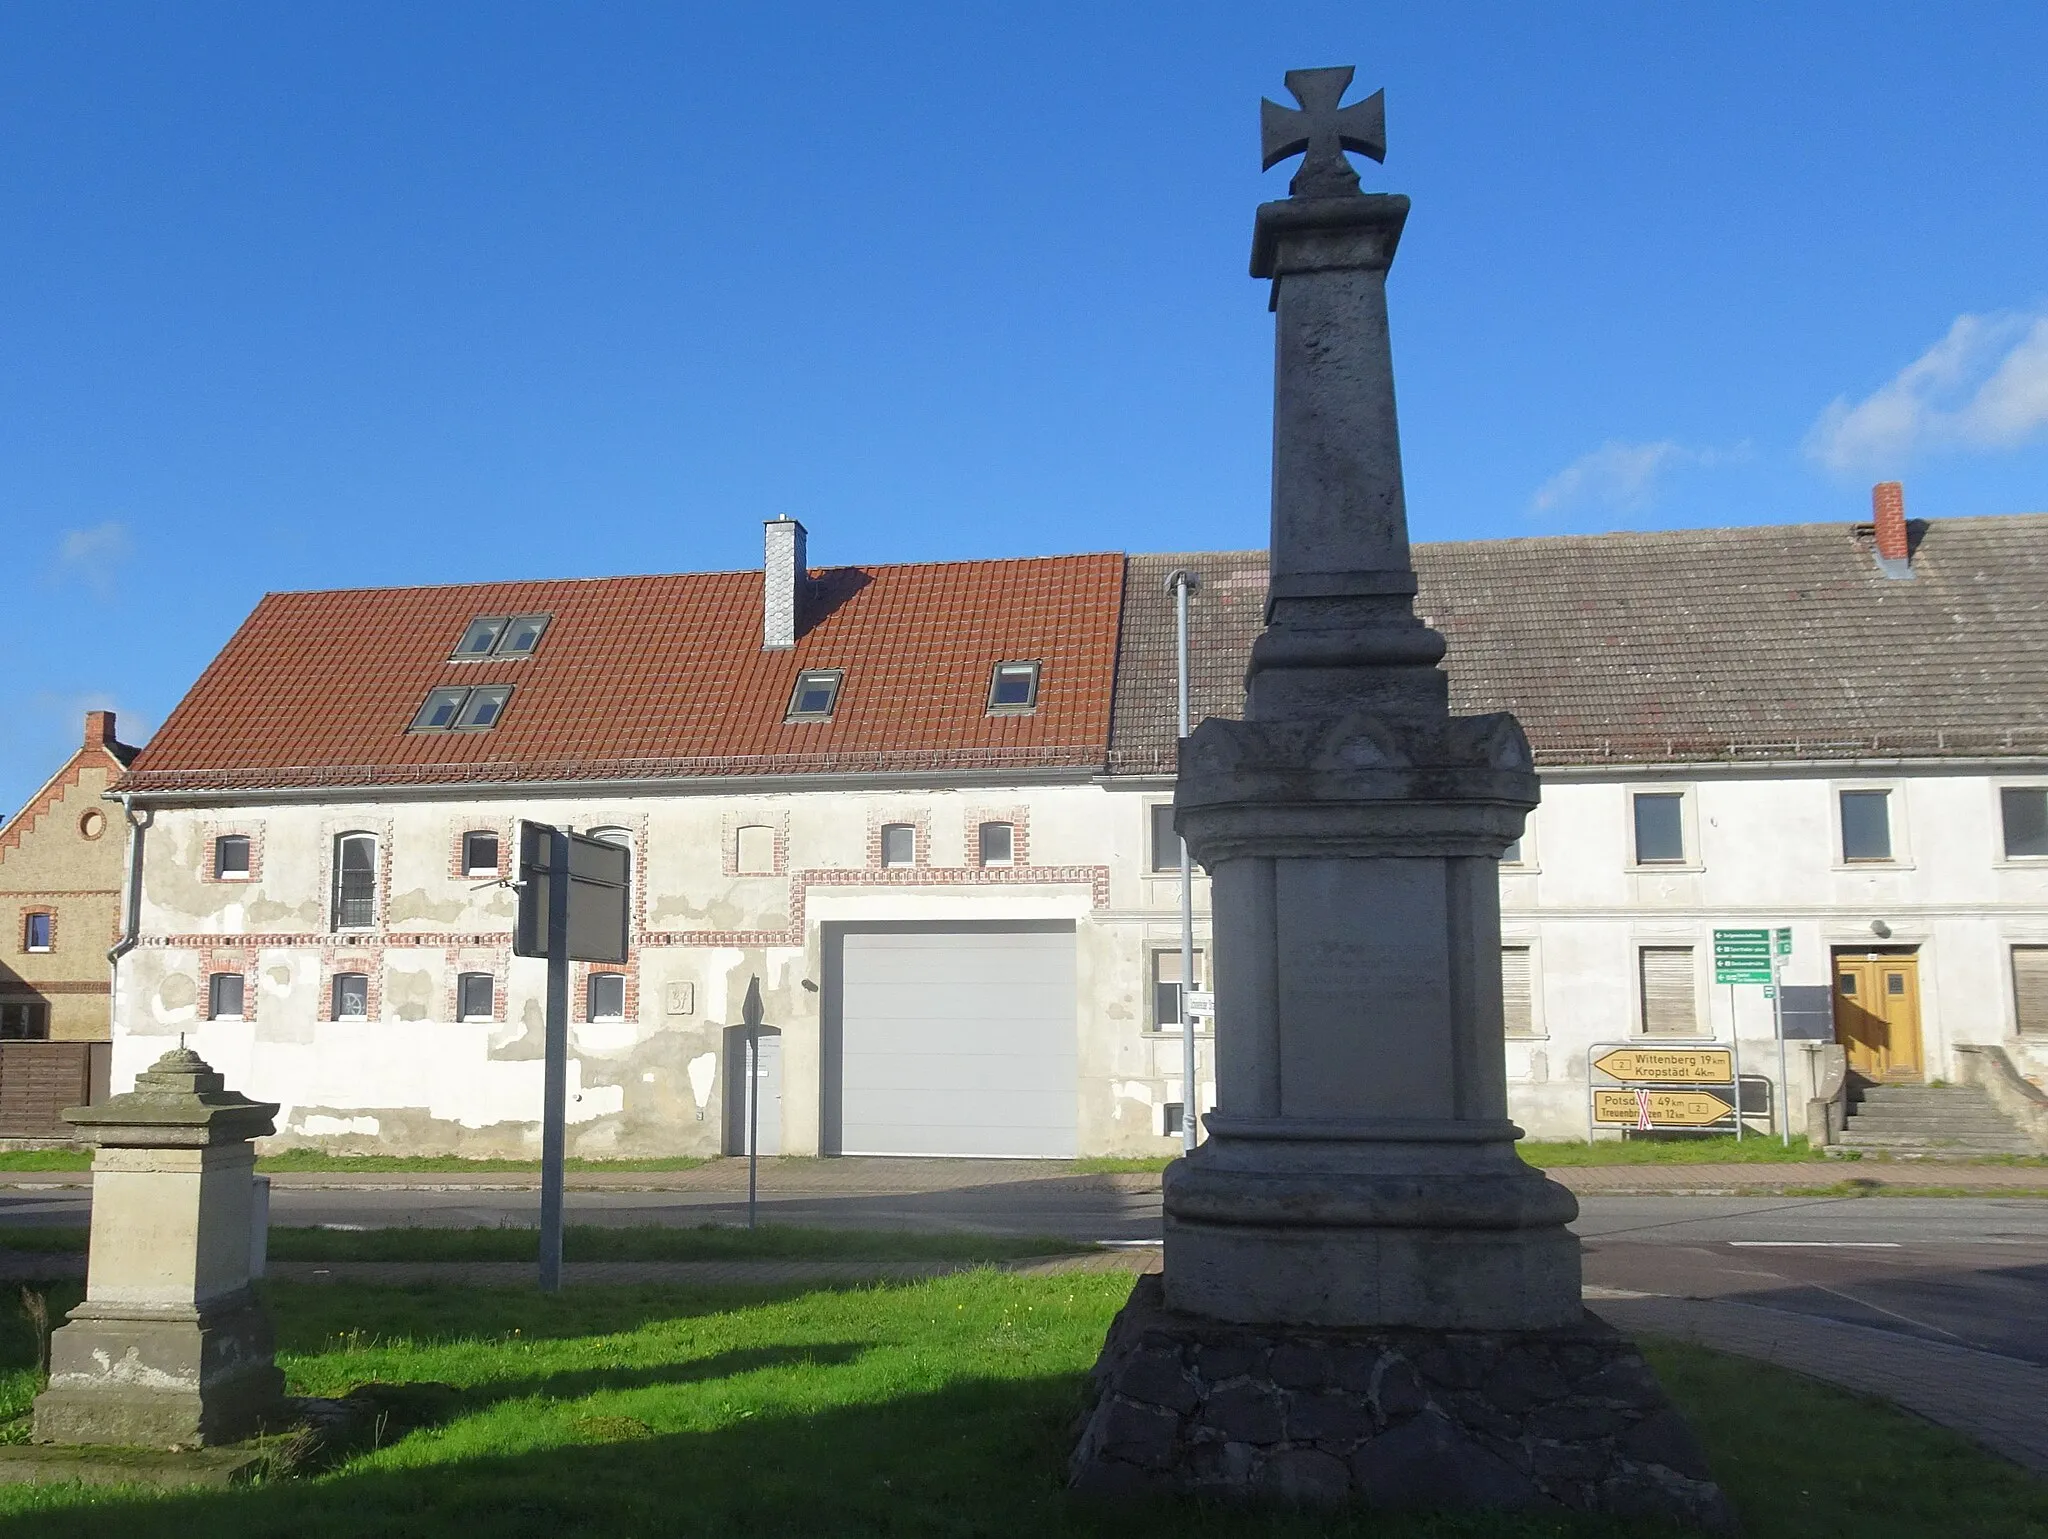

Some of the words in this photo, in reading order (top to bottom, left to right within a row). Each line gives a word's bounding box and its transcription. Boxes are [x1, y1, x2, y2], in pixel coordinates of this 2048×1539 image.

[1635, 1054, 1696, 1066] Wittenberg
[1635, 1067, 1690, 1077] Kropstädt
[1601, 1107, 1662, 1119] Treuenbrizen
